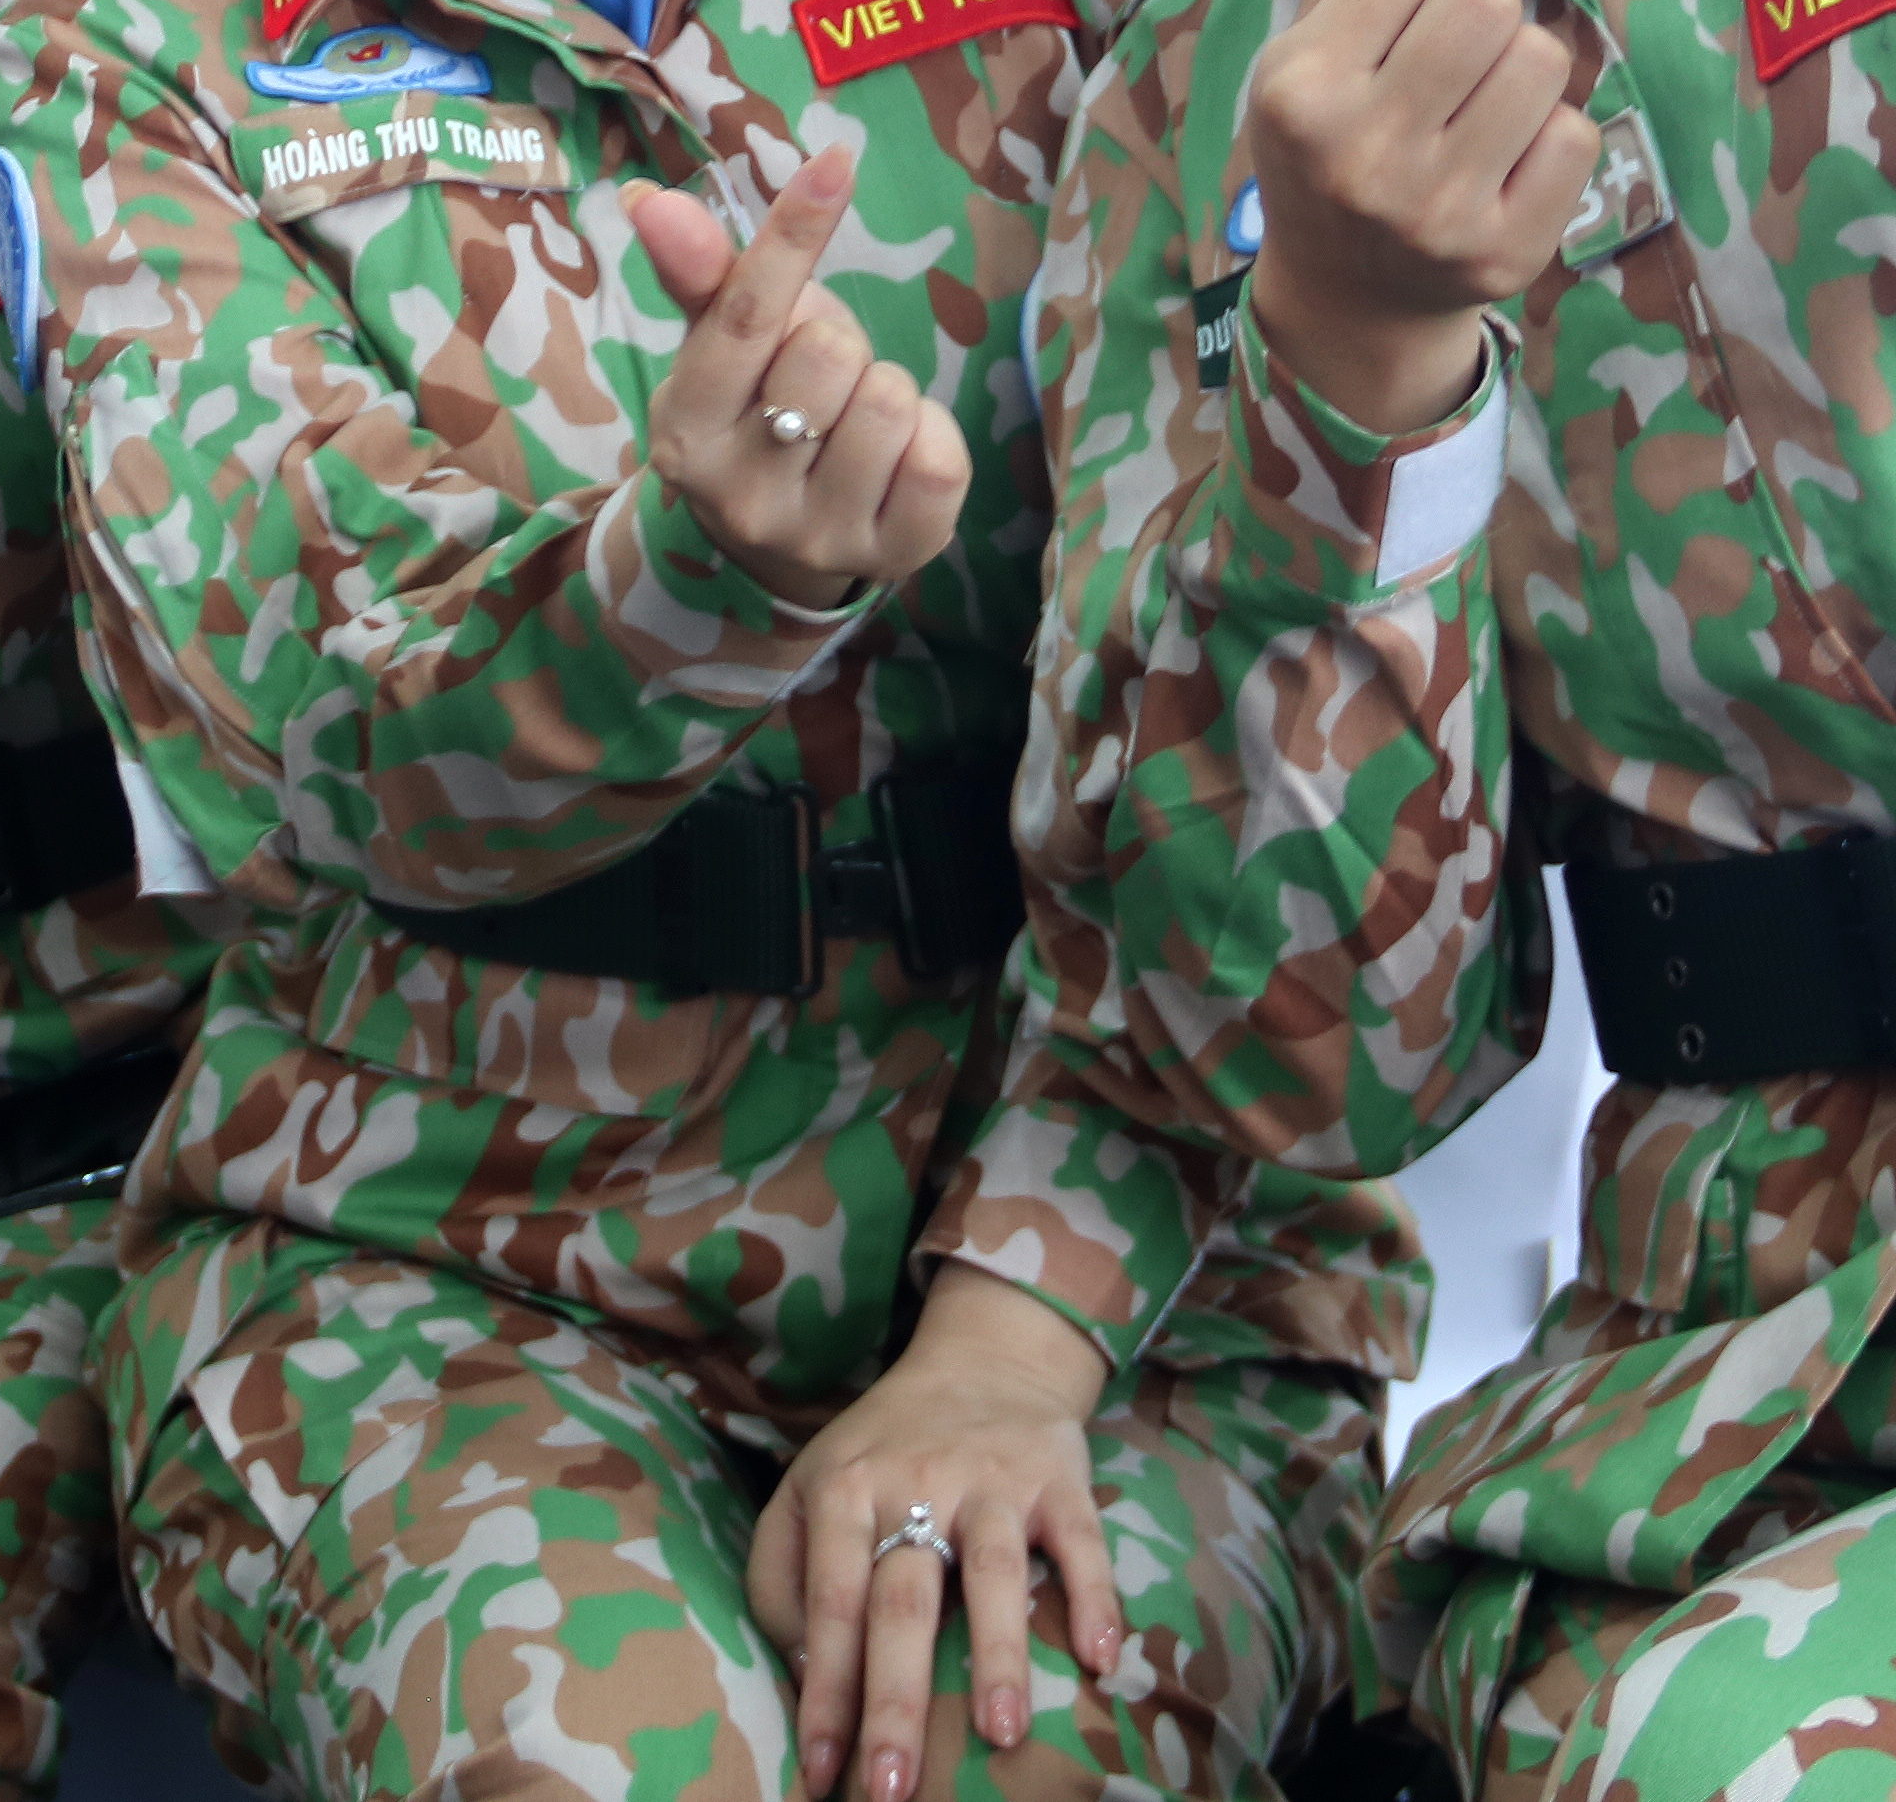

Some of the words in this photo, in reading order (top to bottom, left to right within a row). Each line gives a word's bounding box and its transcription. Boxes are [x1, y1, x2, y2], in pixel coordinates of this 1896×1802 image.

[261, 128, 371, 189] HOÀNG
[375, 117, 440, 161] THU
[445, 118, 546, 163] TRANG
